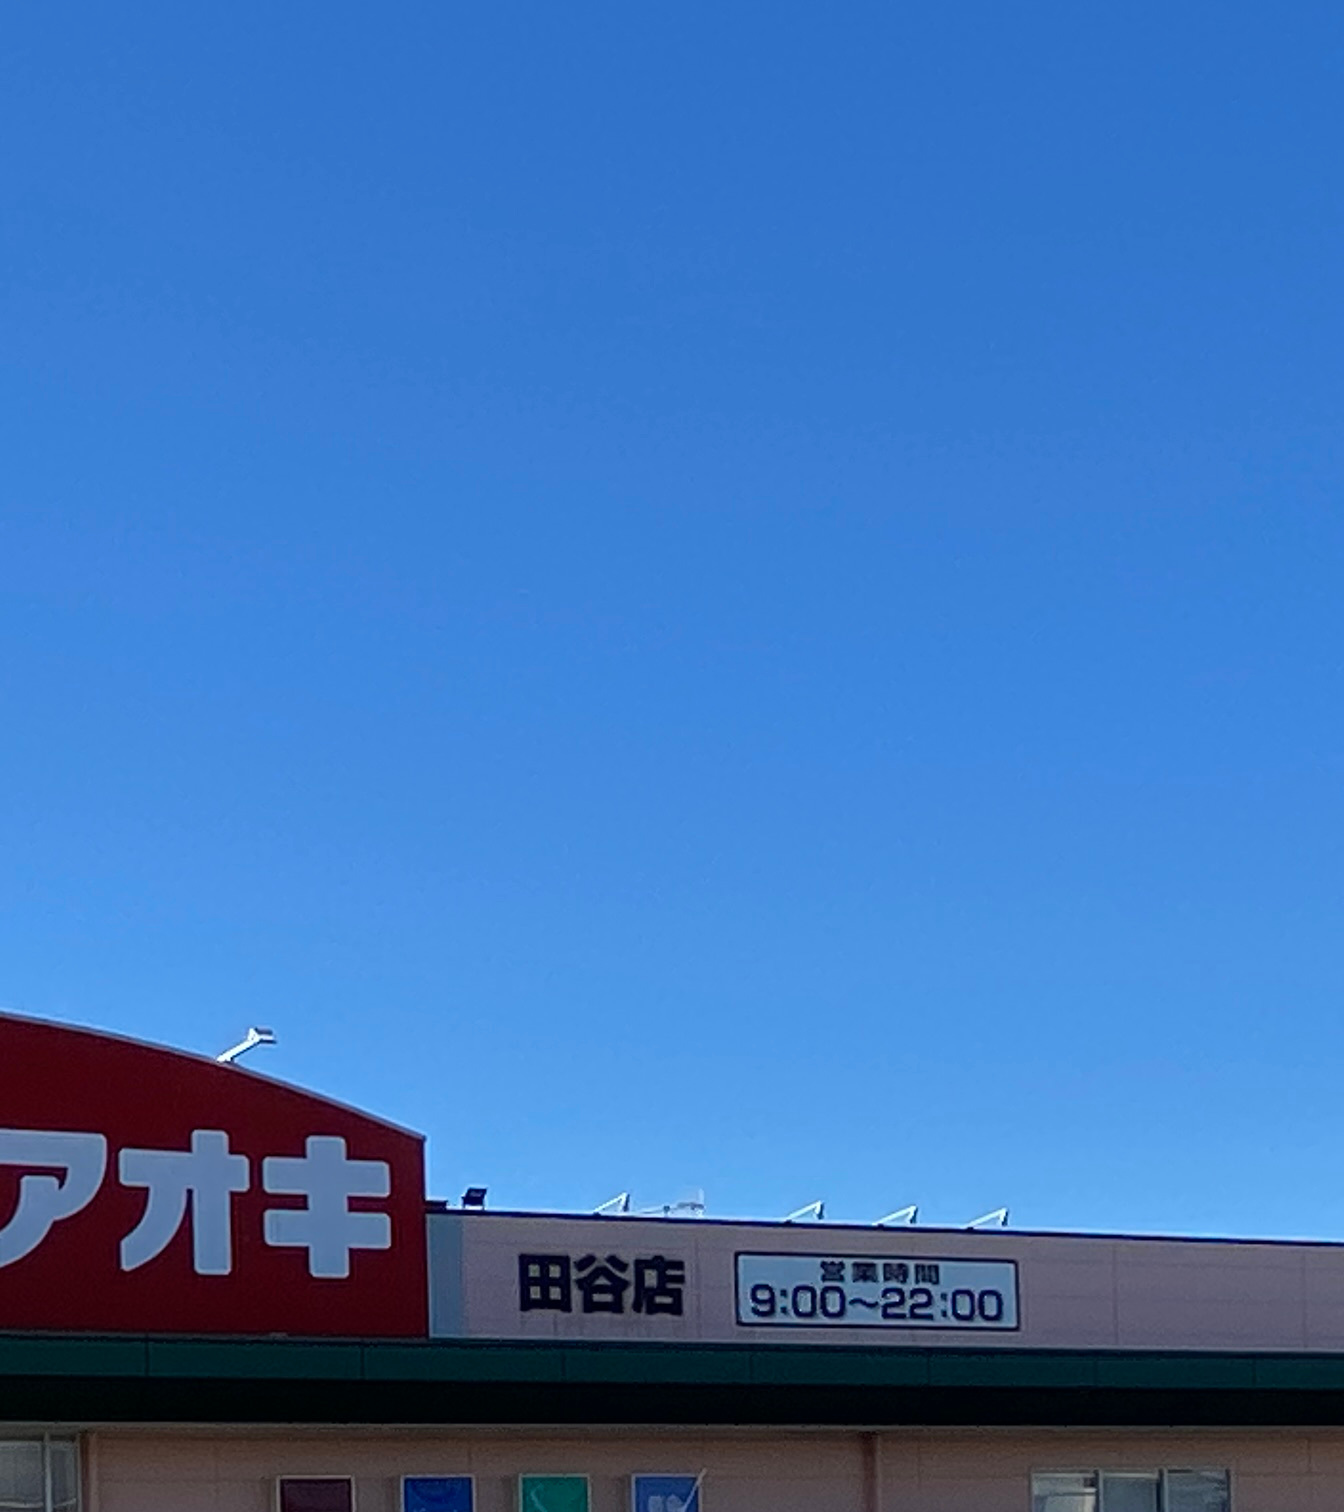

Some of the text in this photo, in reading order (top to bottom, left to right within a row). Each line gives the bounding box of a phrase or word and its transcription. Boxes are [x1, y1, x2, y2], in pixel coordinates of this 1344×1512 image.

[517, 1252, 686, 1317] 田谷店
[820, 1260, 940, 1285] 営業時間
